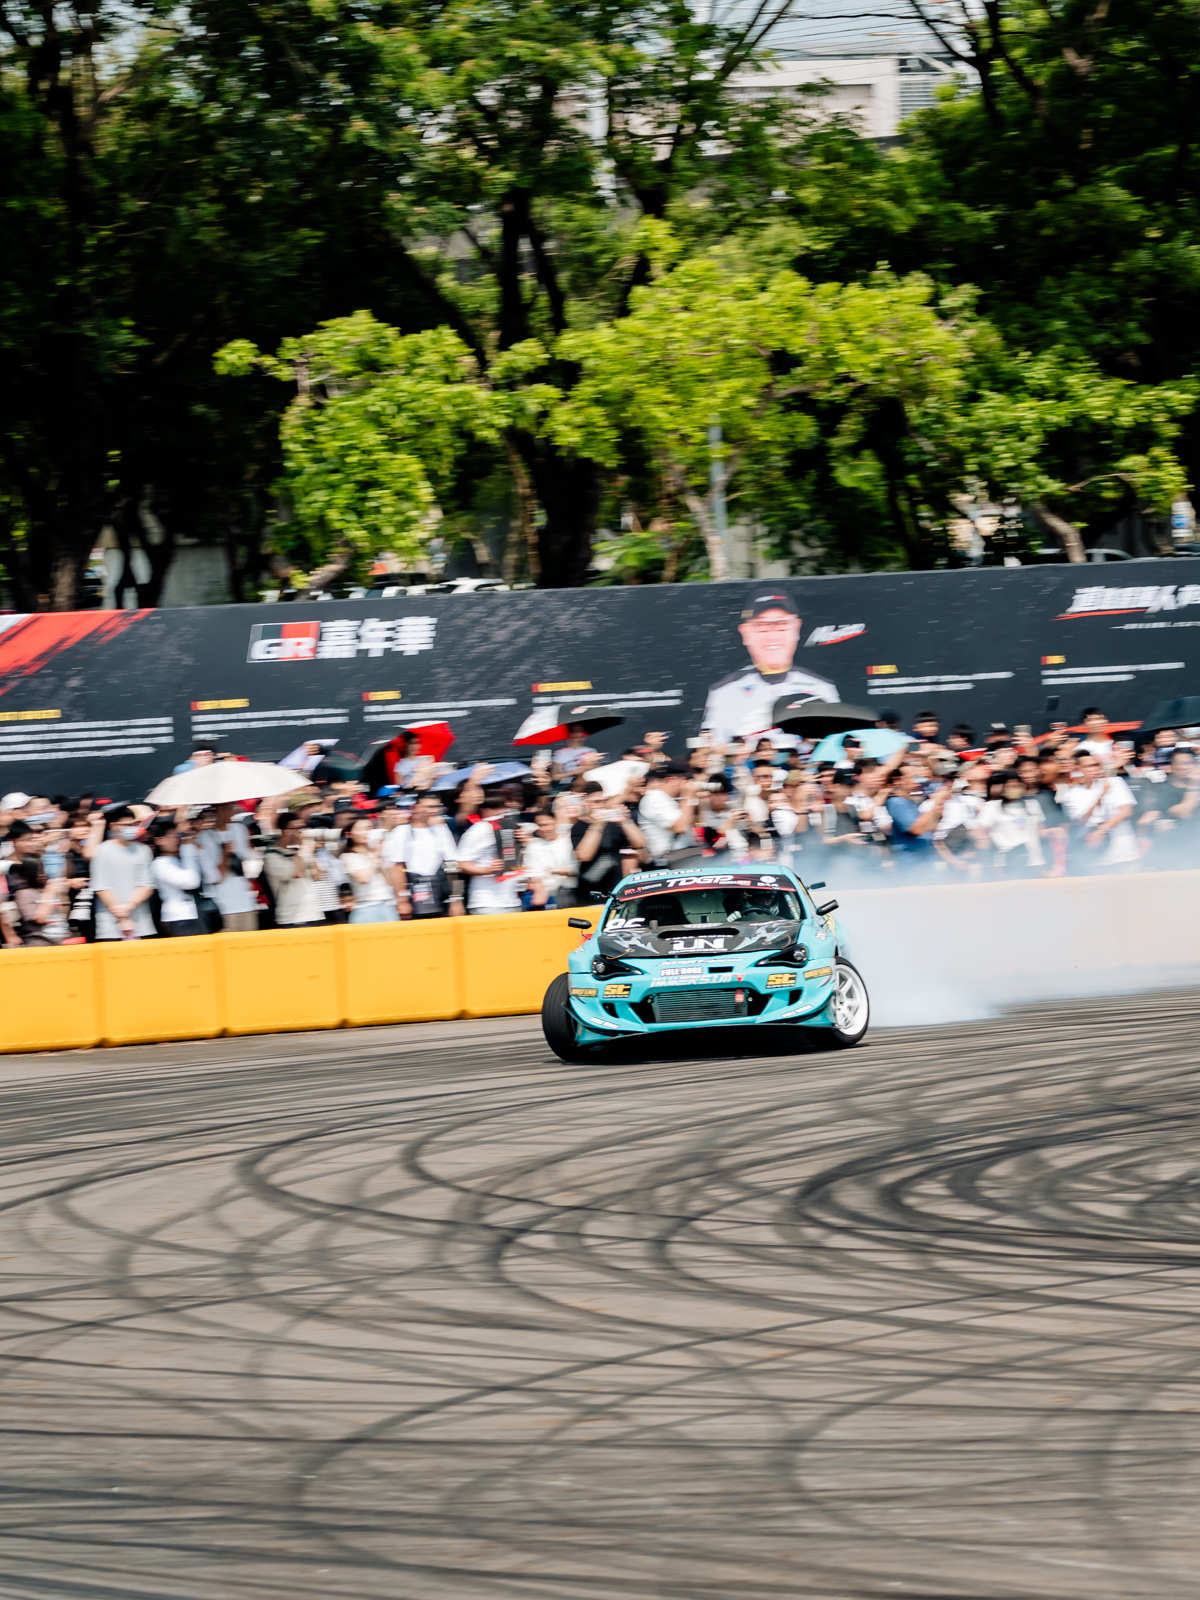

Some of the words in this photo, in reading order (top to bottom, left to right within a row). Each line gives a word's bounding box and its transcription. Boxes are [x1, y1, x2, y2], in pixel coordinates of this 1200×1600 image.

[317, 616, 438, 659] 嘉年華
[250, 637, 317, 660] GR
[666, 875, 734, 888] TDGP
[661, 967, 680, 977] FULL
